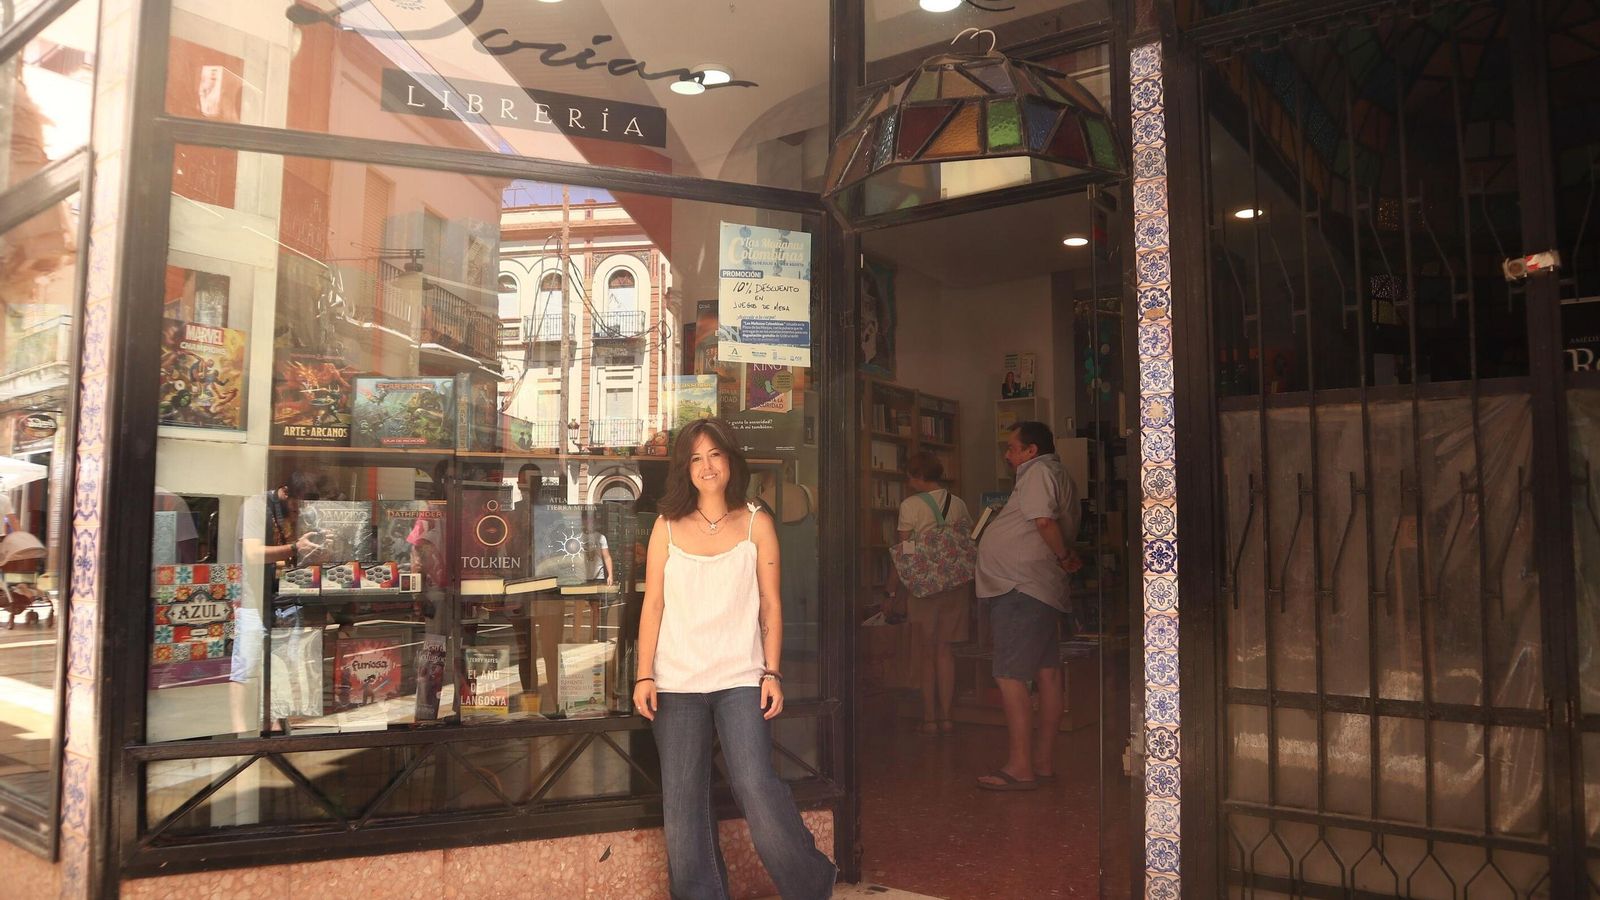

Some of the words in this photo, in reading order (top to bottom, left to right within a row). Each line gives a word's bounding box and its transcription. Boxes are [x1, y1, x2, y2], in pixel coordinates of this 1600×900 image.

[407, 86, 645, 138] LIBRERÍA
[733, 281, 752, 294] 10%
[755, 283, 800, 293] DESCUENTO
[185, 324, 223, 346] MARVEL
[180, 341, 226, 354] CHAMPIONS
[283, 426, 306, 436] ARTE
[310, 427, 347, 438] ARCANOS
[387, 510, 443, 520] PATHFINDER
[461, 556, 521, 569] TOLKIEN
[178, 604, 220, 619] AZUL
[467, 670, 478, 680] EL
[470, 682, 481, 693] DE
[461, 695, 507, 706] LANGOSTA
